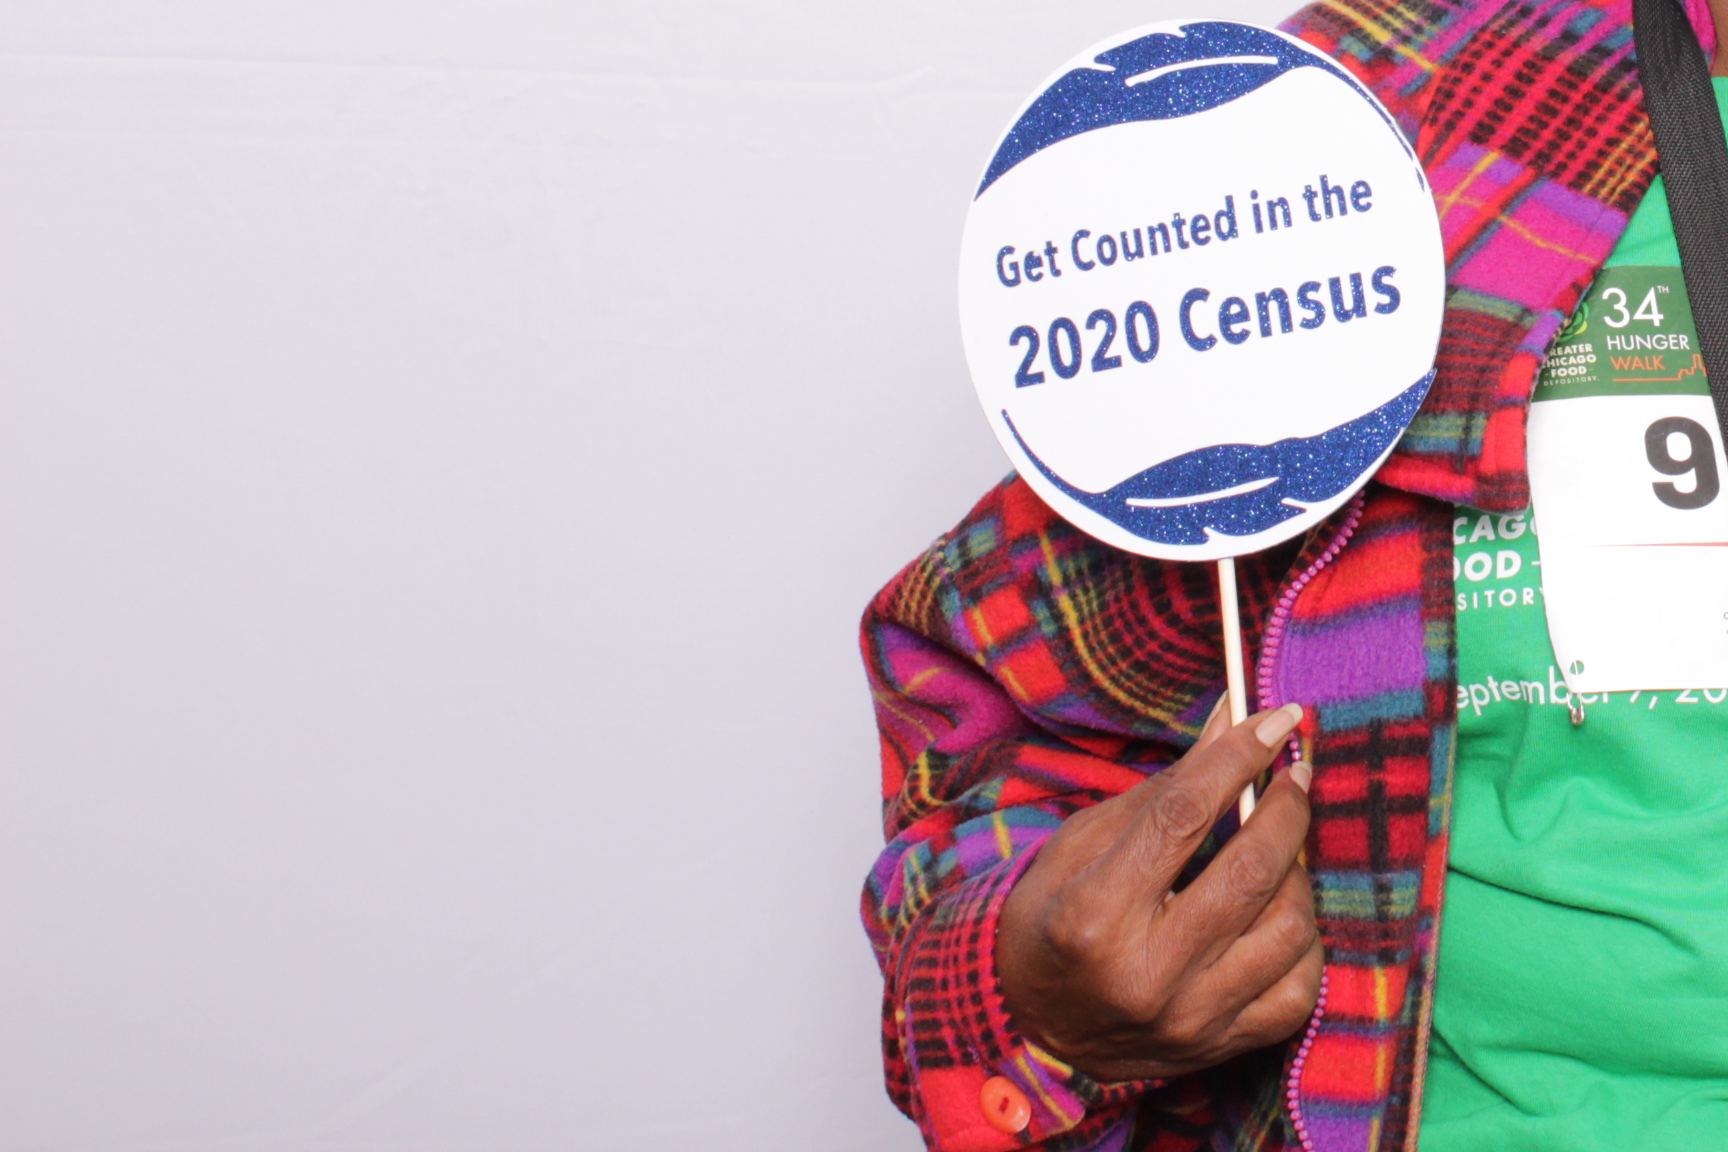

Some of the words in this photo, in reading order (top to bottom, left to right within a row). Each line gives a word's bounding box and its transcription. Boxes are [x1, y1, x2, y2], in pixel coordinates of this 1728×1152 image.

[996, 241, 1062, 288] Get
[1070, 194, 1238, 272] Counted
[1250, 189, 1293, 234] in
[1302, 174, 1373, 223] the
[1008, 300, 1160, 389] 2020
[1179, 265, 1401, 352] Census
[1549, 343, 1593, 357] REATER
[1606, 334, 1690, 351] HUNGER
[1543, 355, 1597, 369] HICAGO
[1610, 355, 1666, 371] WALK
[1551, 366, 1587, 378] FOOD
[1453, 514, 1537, 546] CAG
[1456, 587, 1544, 611] SITOR
